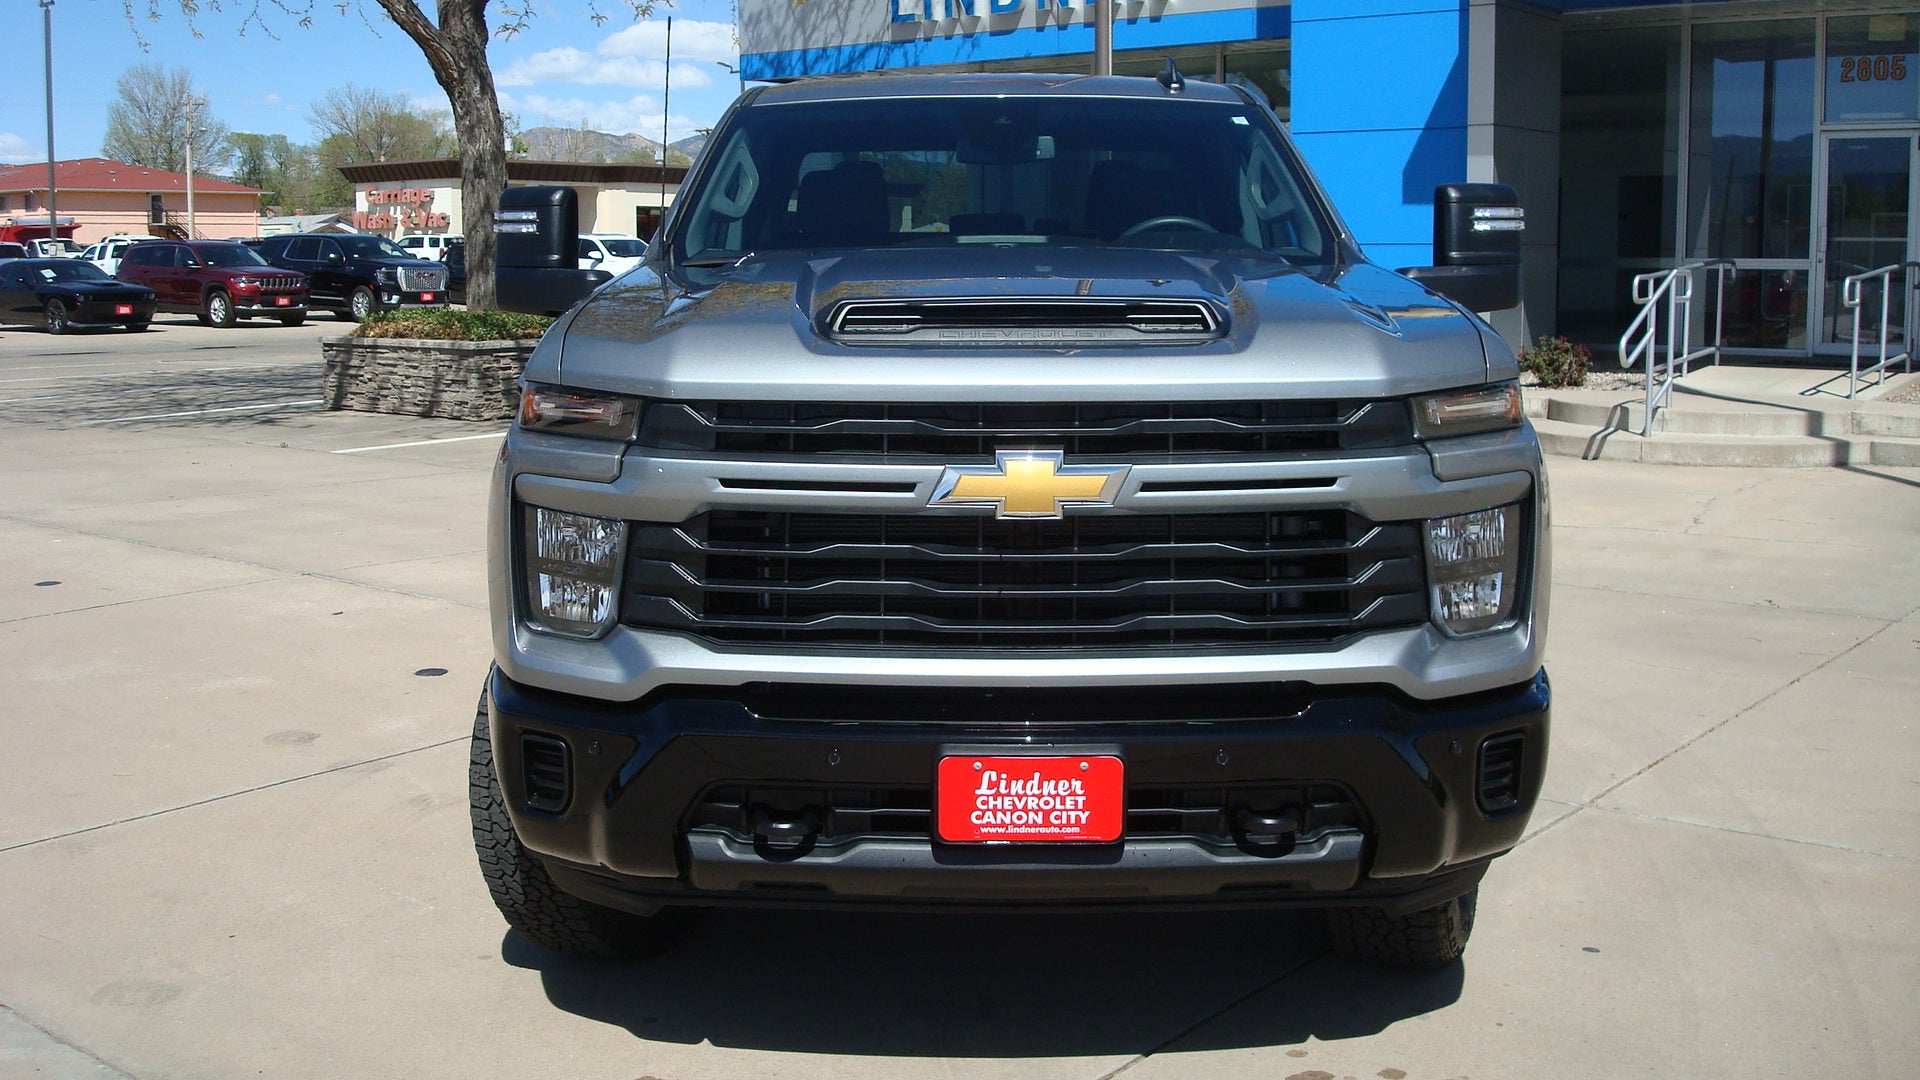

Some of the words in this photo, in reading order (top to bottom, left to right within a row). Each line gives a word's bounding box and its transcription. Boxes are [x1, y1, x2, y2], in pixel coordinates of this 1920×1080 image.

[1841, 56, 1907, 82] 2805
[365, 186, 430, 208] Carriage
[352, 210, 394, 229] Wash
[401, 208, 412, 228] &
[416, 207, 447, 227] Vac
[938, 329, 1111, 339] CHEVROLET
[974, 770, 1085, 796] Lindner
[975, 795, 1086, 810] CHEVROLET
[970, 810, 1043, 825] CANON
[1049, 810, 1091, 825] CITY
[979, 825, 1081, 834] www.lindnerauto.com
